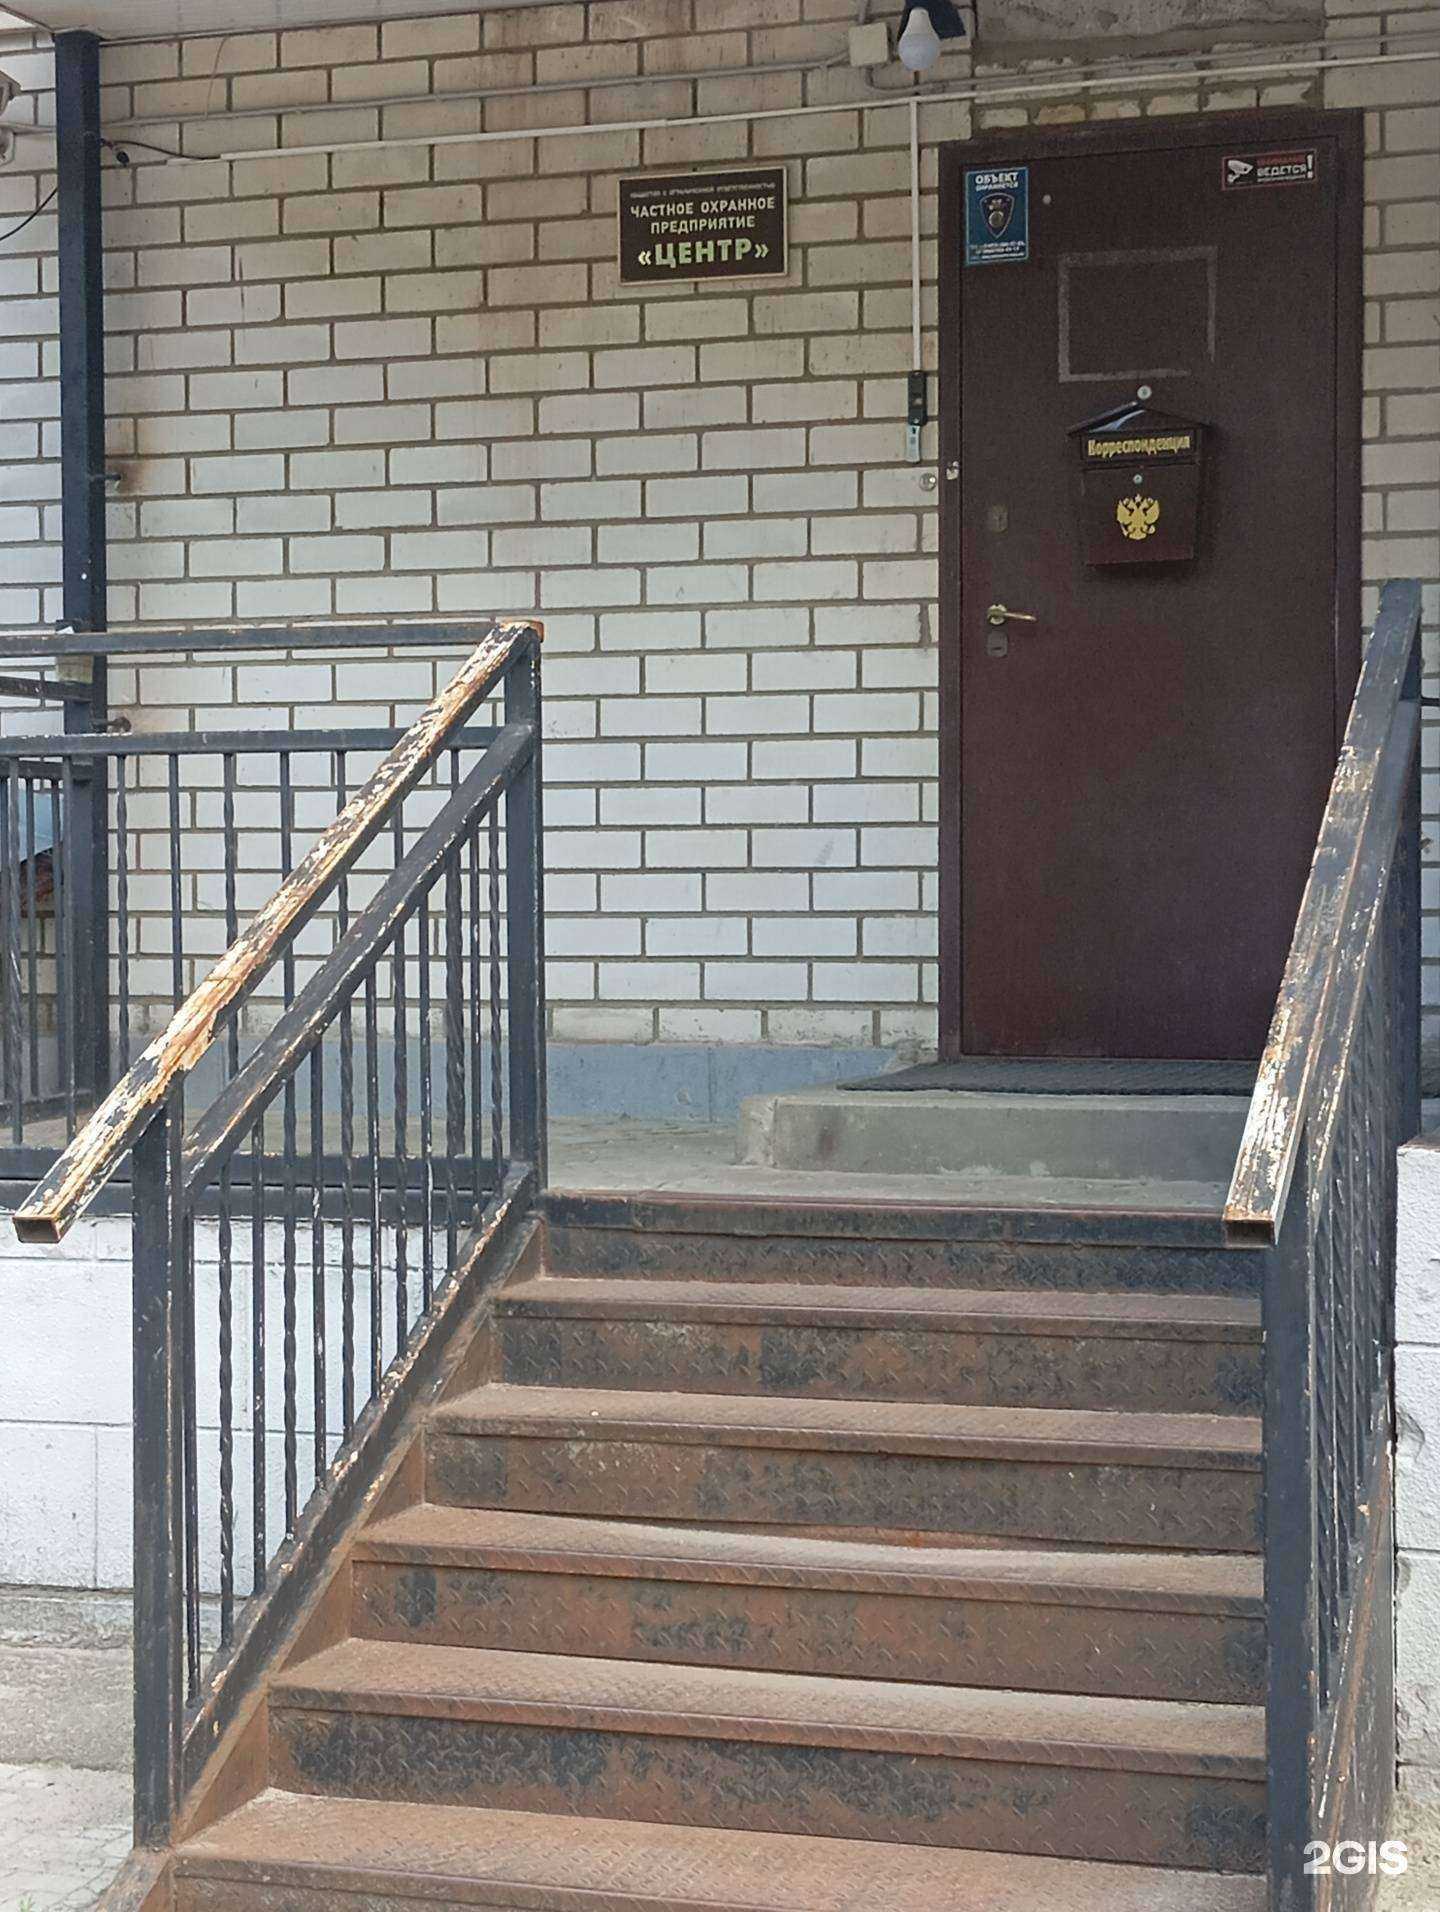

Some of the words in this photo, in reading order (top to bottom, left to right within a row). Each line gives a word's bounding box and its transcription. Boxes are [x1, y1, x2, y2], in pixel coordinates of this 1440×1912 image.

[975, 172, 1018, 184] ОБЪЕКТ
[630, 203, 693, 218] ЧАСТНОЕ
[700, 197, 775, 213] ОХРАННОЕ
[650, 216, 755, 234] ПРЕДПРИЯТИЕ
[638, 238, 769, 268] «ЦЕНТР»
[1088, 436, 1190, 458] Корреспонденция
